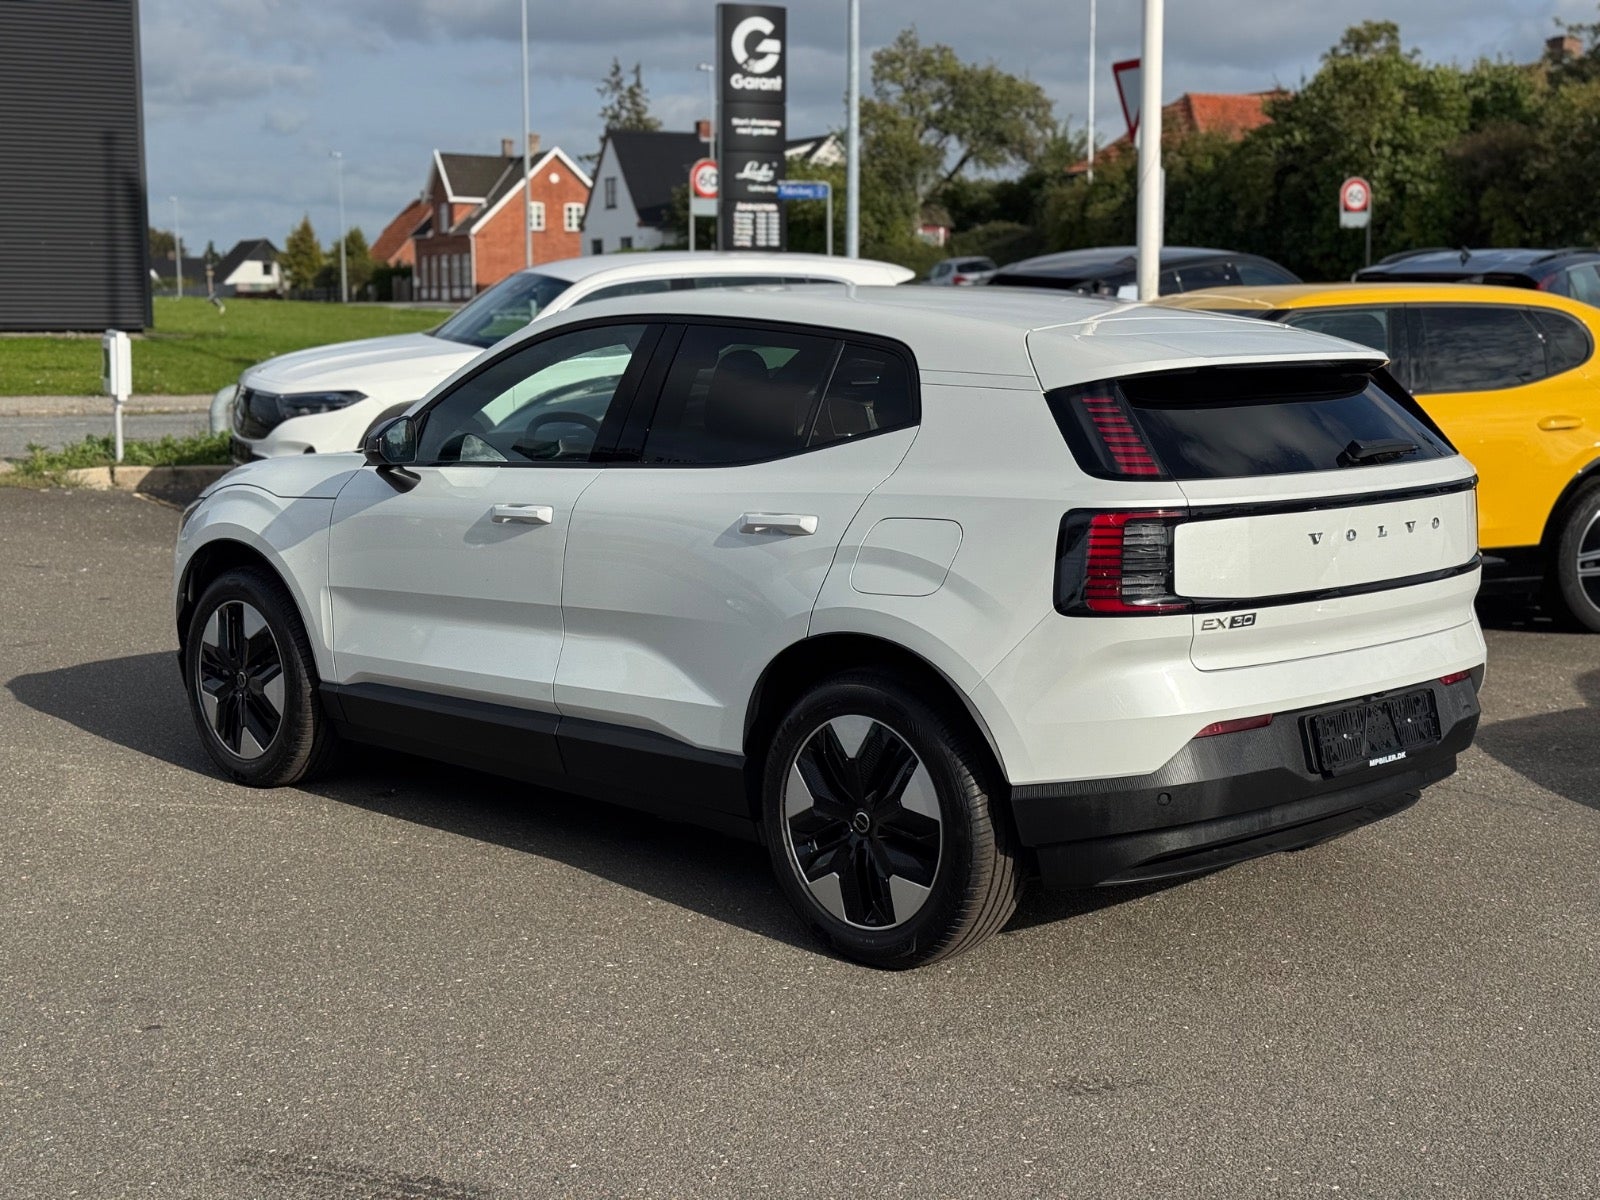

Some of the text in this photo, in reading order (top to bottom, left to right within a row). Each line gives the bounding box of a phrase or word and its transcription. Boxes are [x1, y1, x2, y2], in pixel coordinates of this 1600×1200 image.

[730, 73, 782, 91] Garant
[698, 171, 718, 187] 60
[1308, 517, 1440, 545] VOLVO
[1201, 612, 1256, 631] EX30
